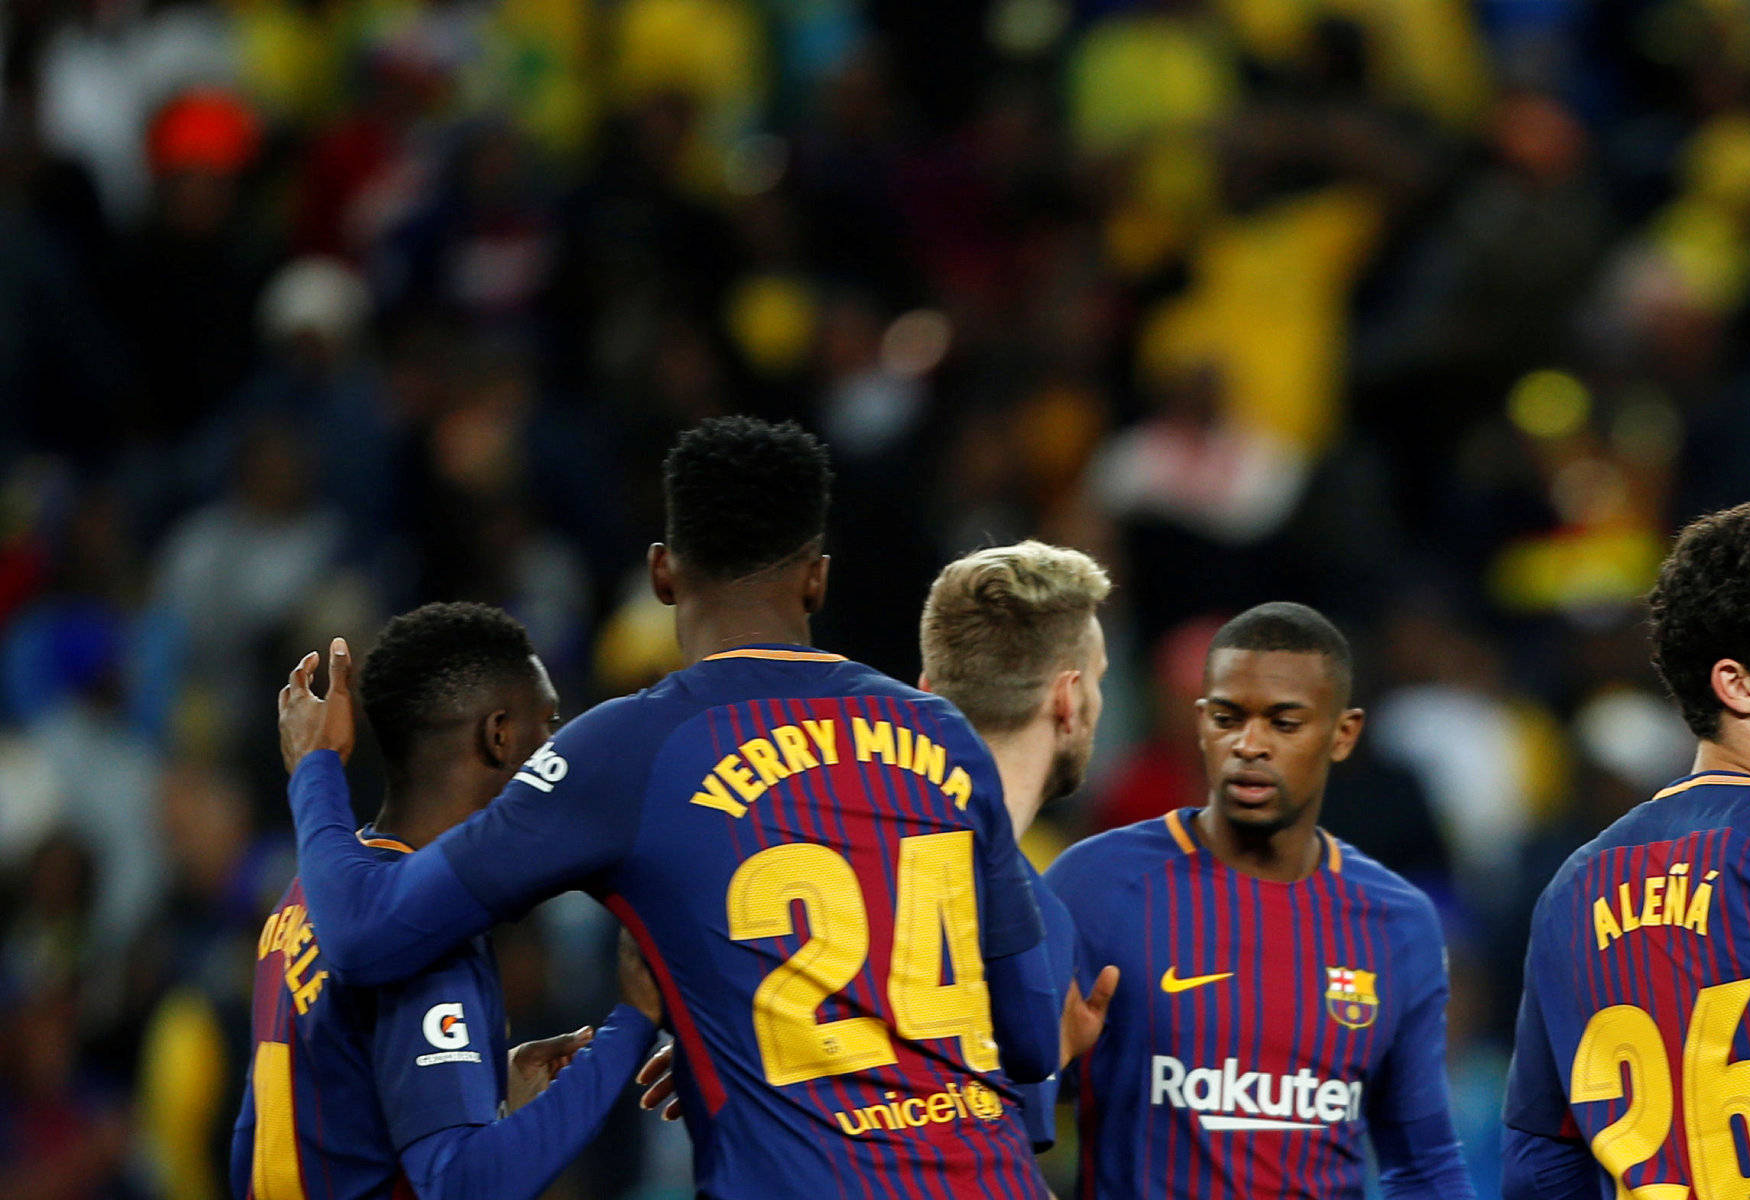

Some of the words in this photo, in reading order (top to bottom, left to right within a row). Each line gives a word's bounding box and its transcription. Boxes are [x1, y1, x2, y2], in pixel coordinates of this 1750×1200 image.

[523, 741, 569, 782] ko
[689, 719, 840, 819] YERRY
[851, 715, 973, 812] MINA
[1592, 862, 1715, 951] ALEÑÁ
[726, 830, 1002, 1088] 24
[422, 1002, 471, 1051] G
[834, 1082, 968, 1136] unicef
[1151, 1054, 1363, 1123] Rakuten
